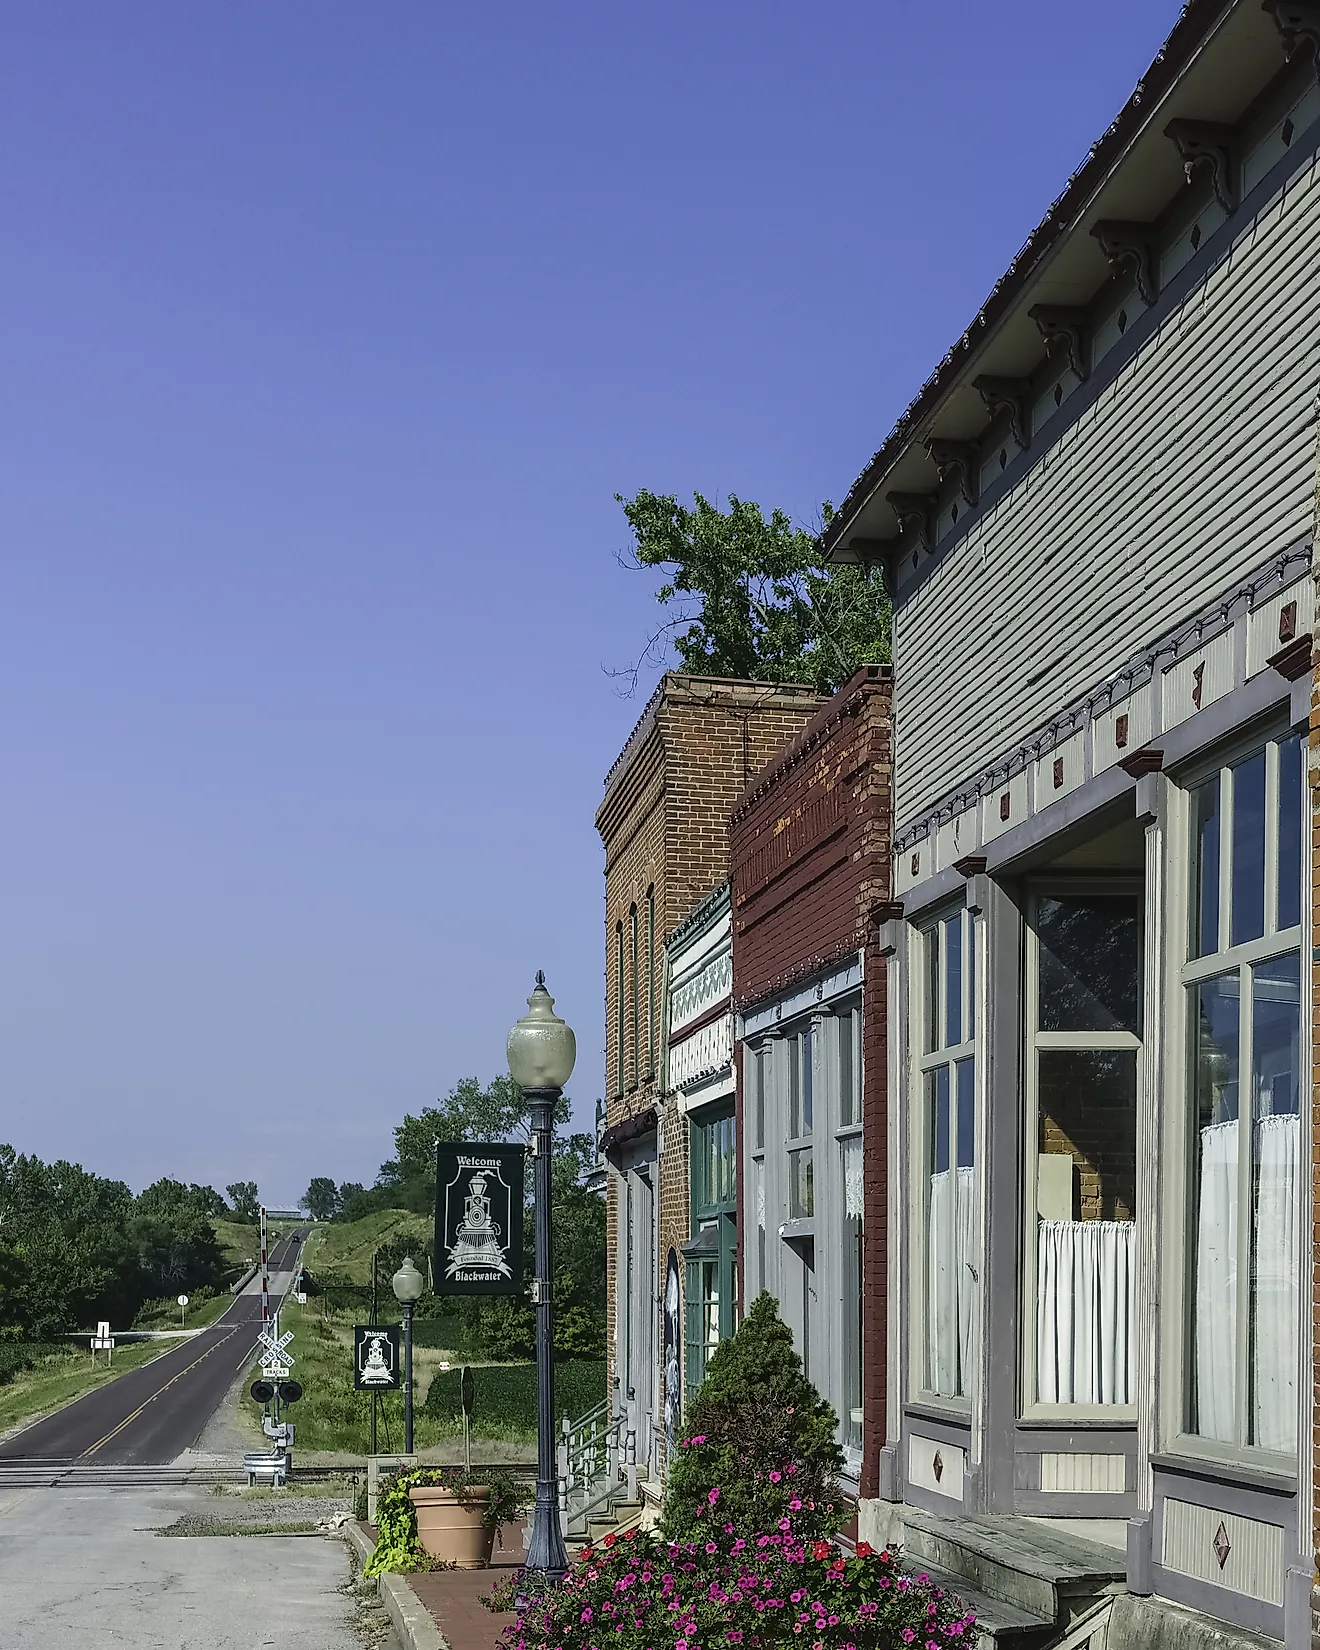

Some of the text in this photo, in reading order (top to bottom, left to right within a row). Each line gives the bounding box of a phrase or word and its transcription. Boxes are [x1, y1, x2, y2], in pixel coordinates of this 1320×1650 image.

[456, 1155, 502, 1167] Welcome
[460, 1253, 484, 1262] Founded
[454, 1271, 502, 1281] Blackwater
[273, 1360, 279, 1368] 2
